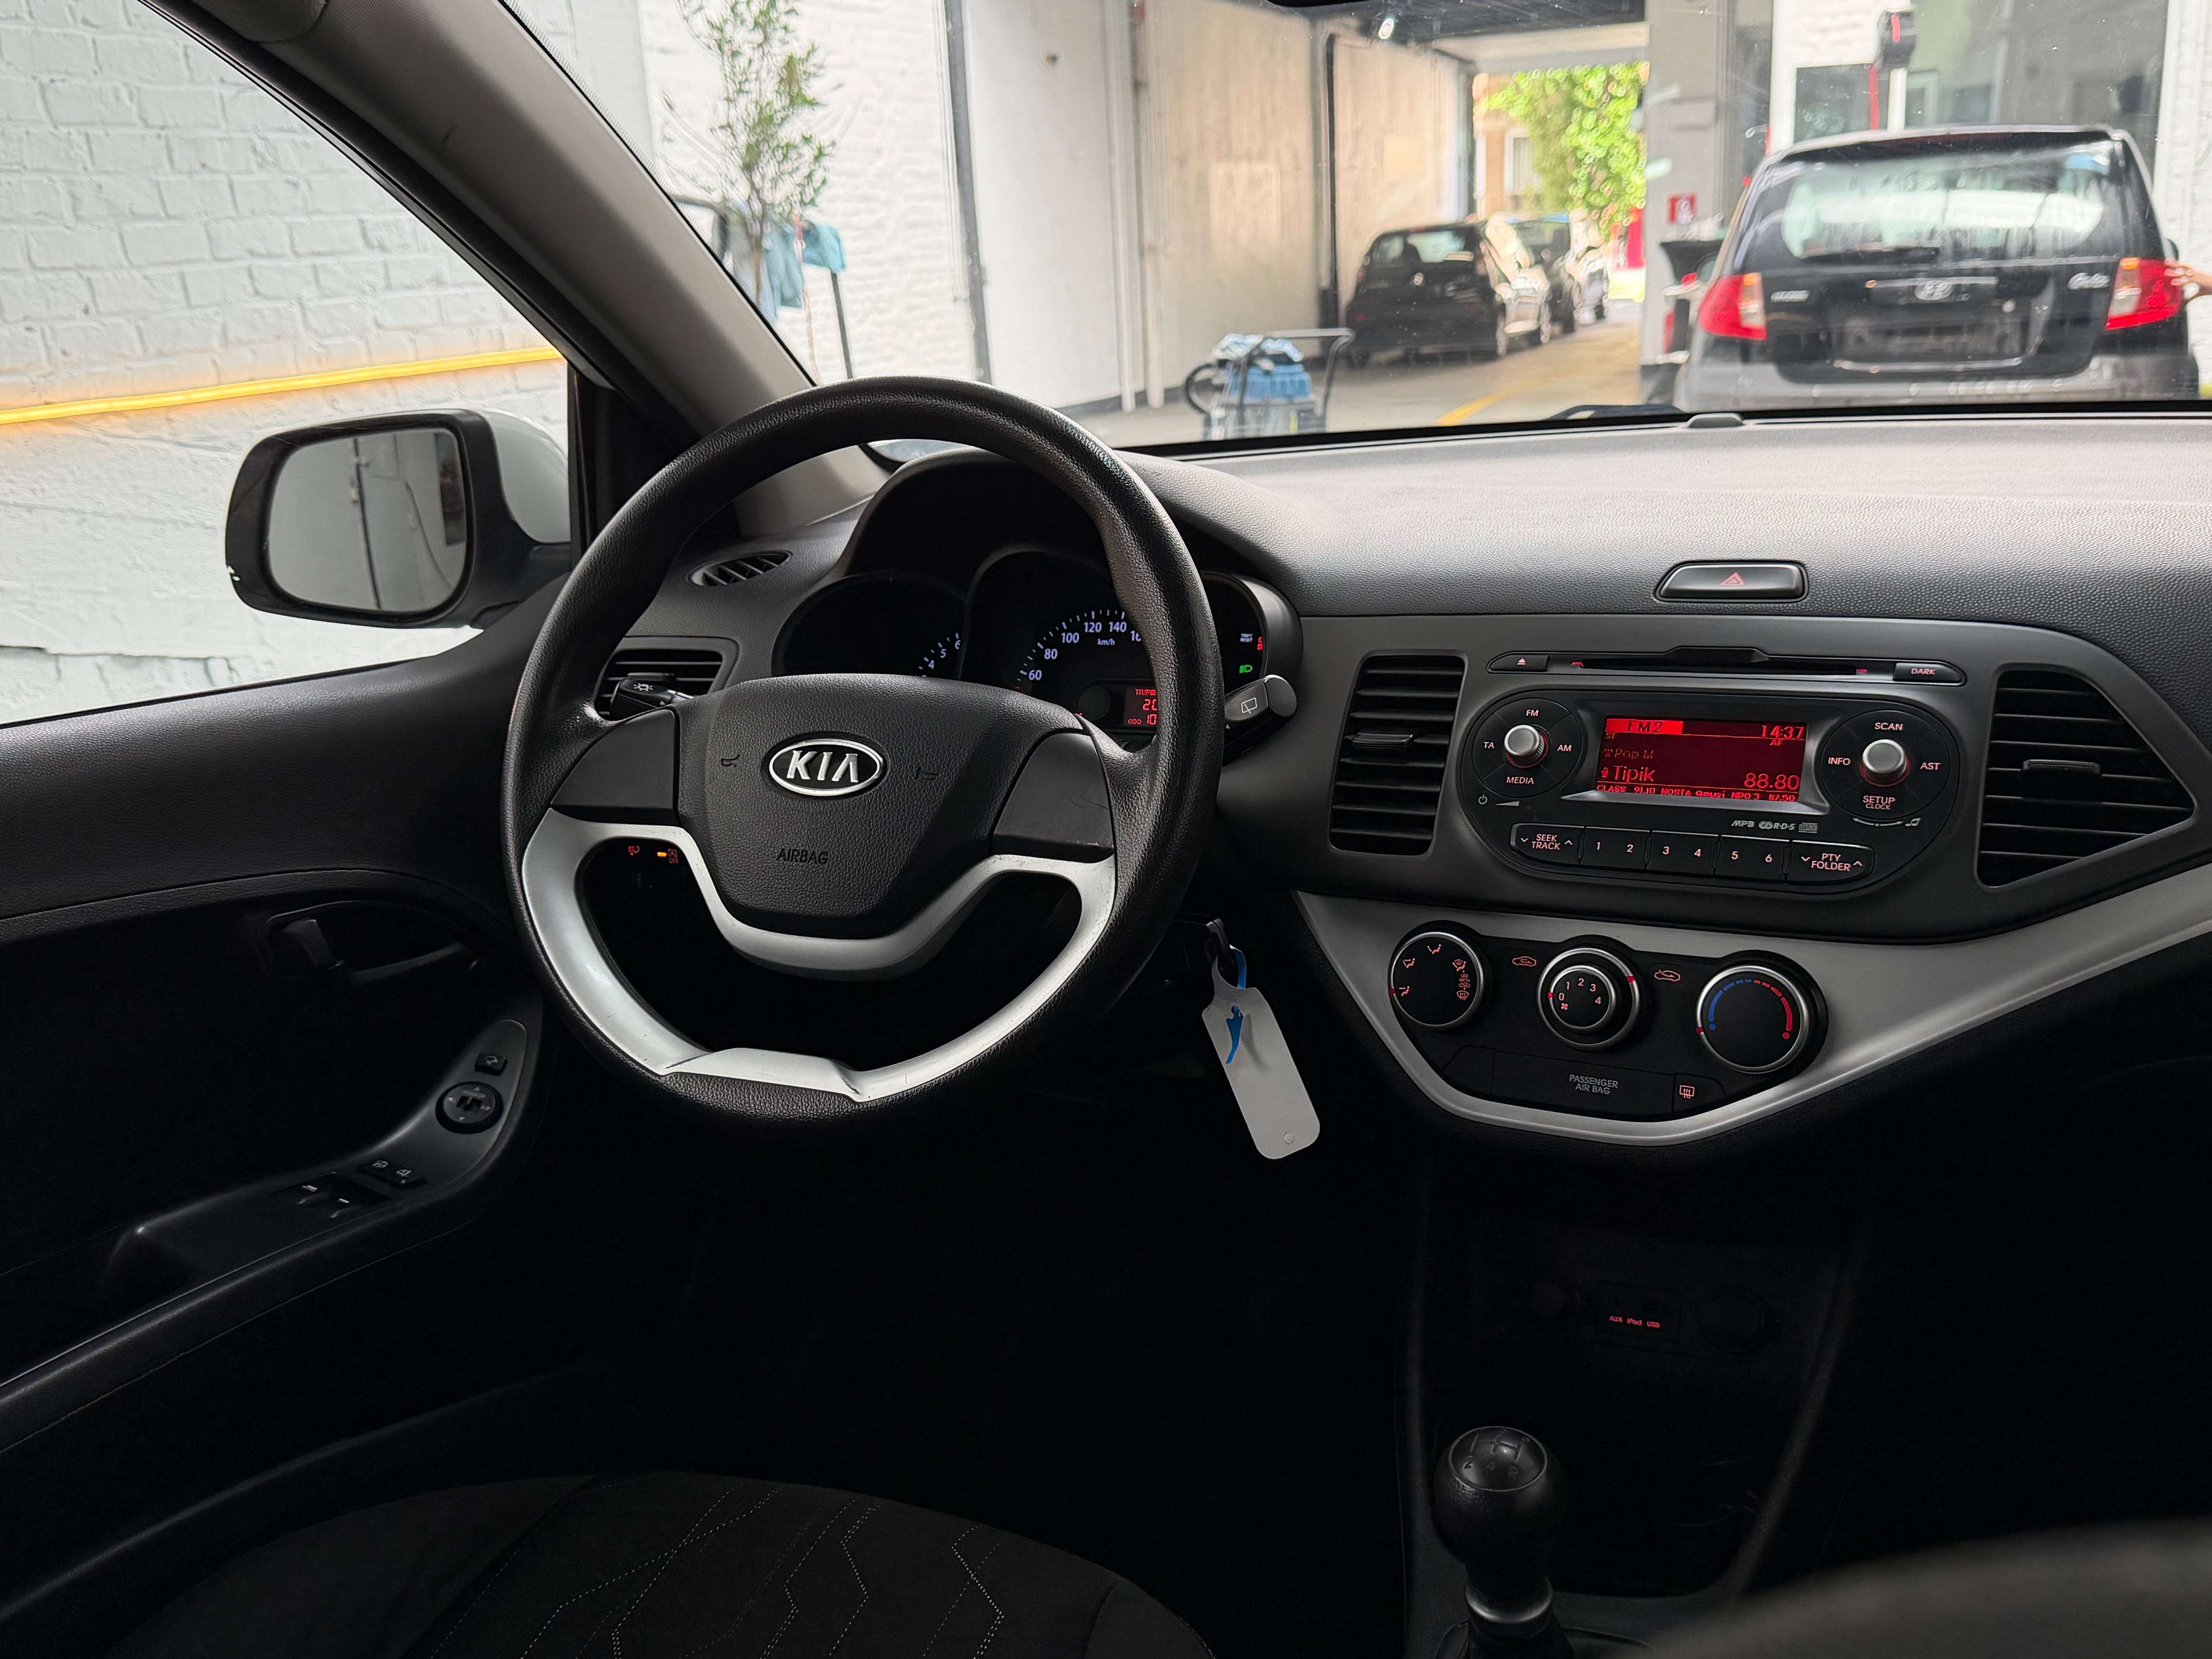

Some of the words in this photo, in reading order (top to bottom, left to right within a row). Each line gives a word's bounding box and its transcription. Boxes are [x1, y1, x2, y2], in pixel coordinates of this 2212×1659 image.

[1084, 622, 1102, 633] 120
[1109, 622, 1127, 632] 140
[1061, 633, 1079, 643] 100
[955, 640, 961, 649] 6
[940, 649, 946, 658] 5
[1044, 649, 1058, 659] 80
[928, 660, 934, 670] 4
[1028, 670, 1042, 680] 60
[1874, 722, 1903, 731] SCAN
[1762, 725, 1804, 740] 14:37
[1828, 757, 1850, 765] INFO
[787, 750, 859, 783] KIA
[1614, 766, 1655, 783] Tipik
[1744, 773, 1799, 790] 88.80
[1863, 795, 1896, 804] SETUP
[1536, 834, 1557, 842] SEEK
[1531, 841, 1560, 850] TRACK
[1626, 845, 1633, 853] 2
[1662, 847, 1669, 855] 3
[1694, 849, 1701, 857] 4
[1731, 851, 1738, 860] 5
[776, 848, 829, 864] AIRBAG
[1765, 854, 1772, 862] 6
[1811, 861, 1851, 871] FOLDER
[1566, 982, 1570, 990] 1
[1578, 978, 1584, 986] 2
[1590, 984, 1596, 992] 3
[1559, 993, 1565, 1001] 0
[1595, 996, 1601, 1005] 4
[1569, 1074, 1618, 1089] PASSENGER
[1575, 1083, 1590, 1092] AIR
[1592, 1085, 1611, 1095] BAG
[1463, 1455, 1473, 1469] 2
